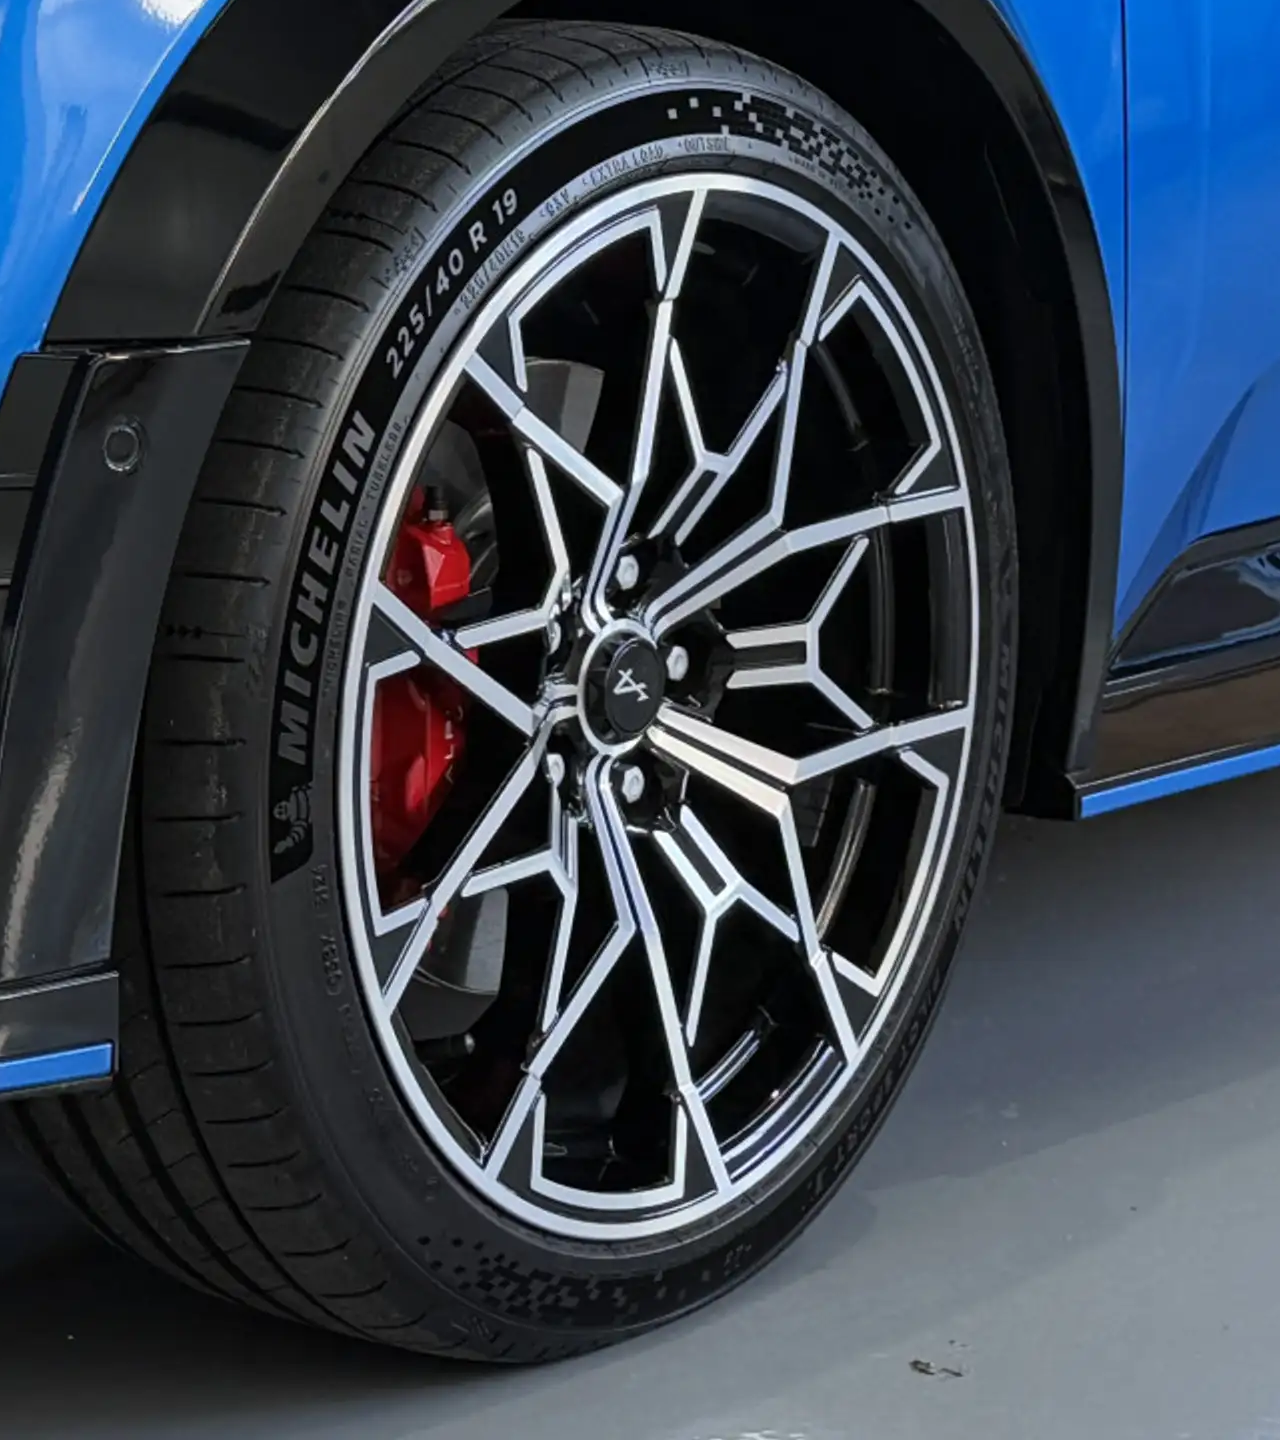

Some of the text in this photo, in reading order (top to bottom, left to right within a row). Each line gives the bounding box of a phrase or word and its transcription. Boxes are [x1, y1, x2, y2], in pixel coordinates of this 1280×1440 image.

[385, 247, 465, 380] 225/40
[468, 219, 490, 254] R
[491, 187, 519, 226] 19
[276, 410, 377, 766] MICHELIN
